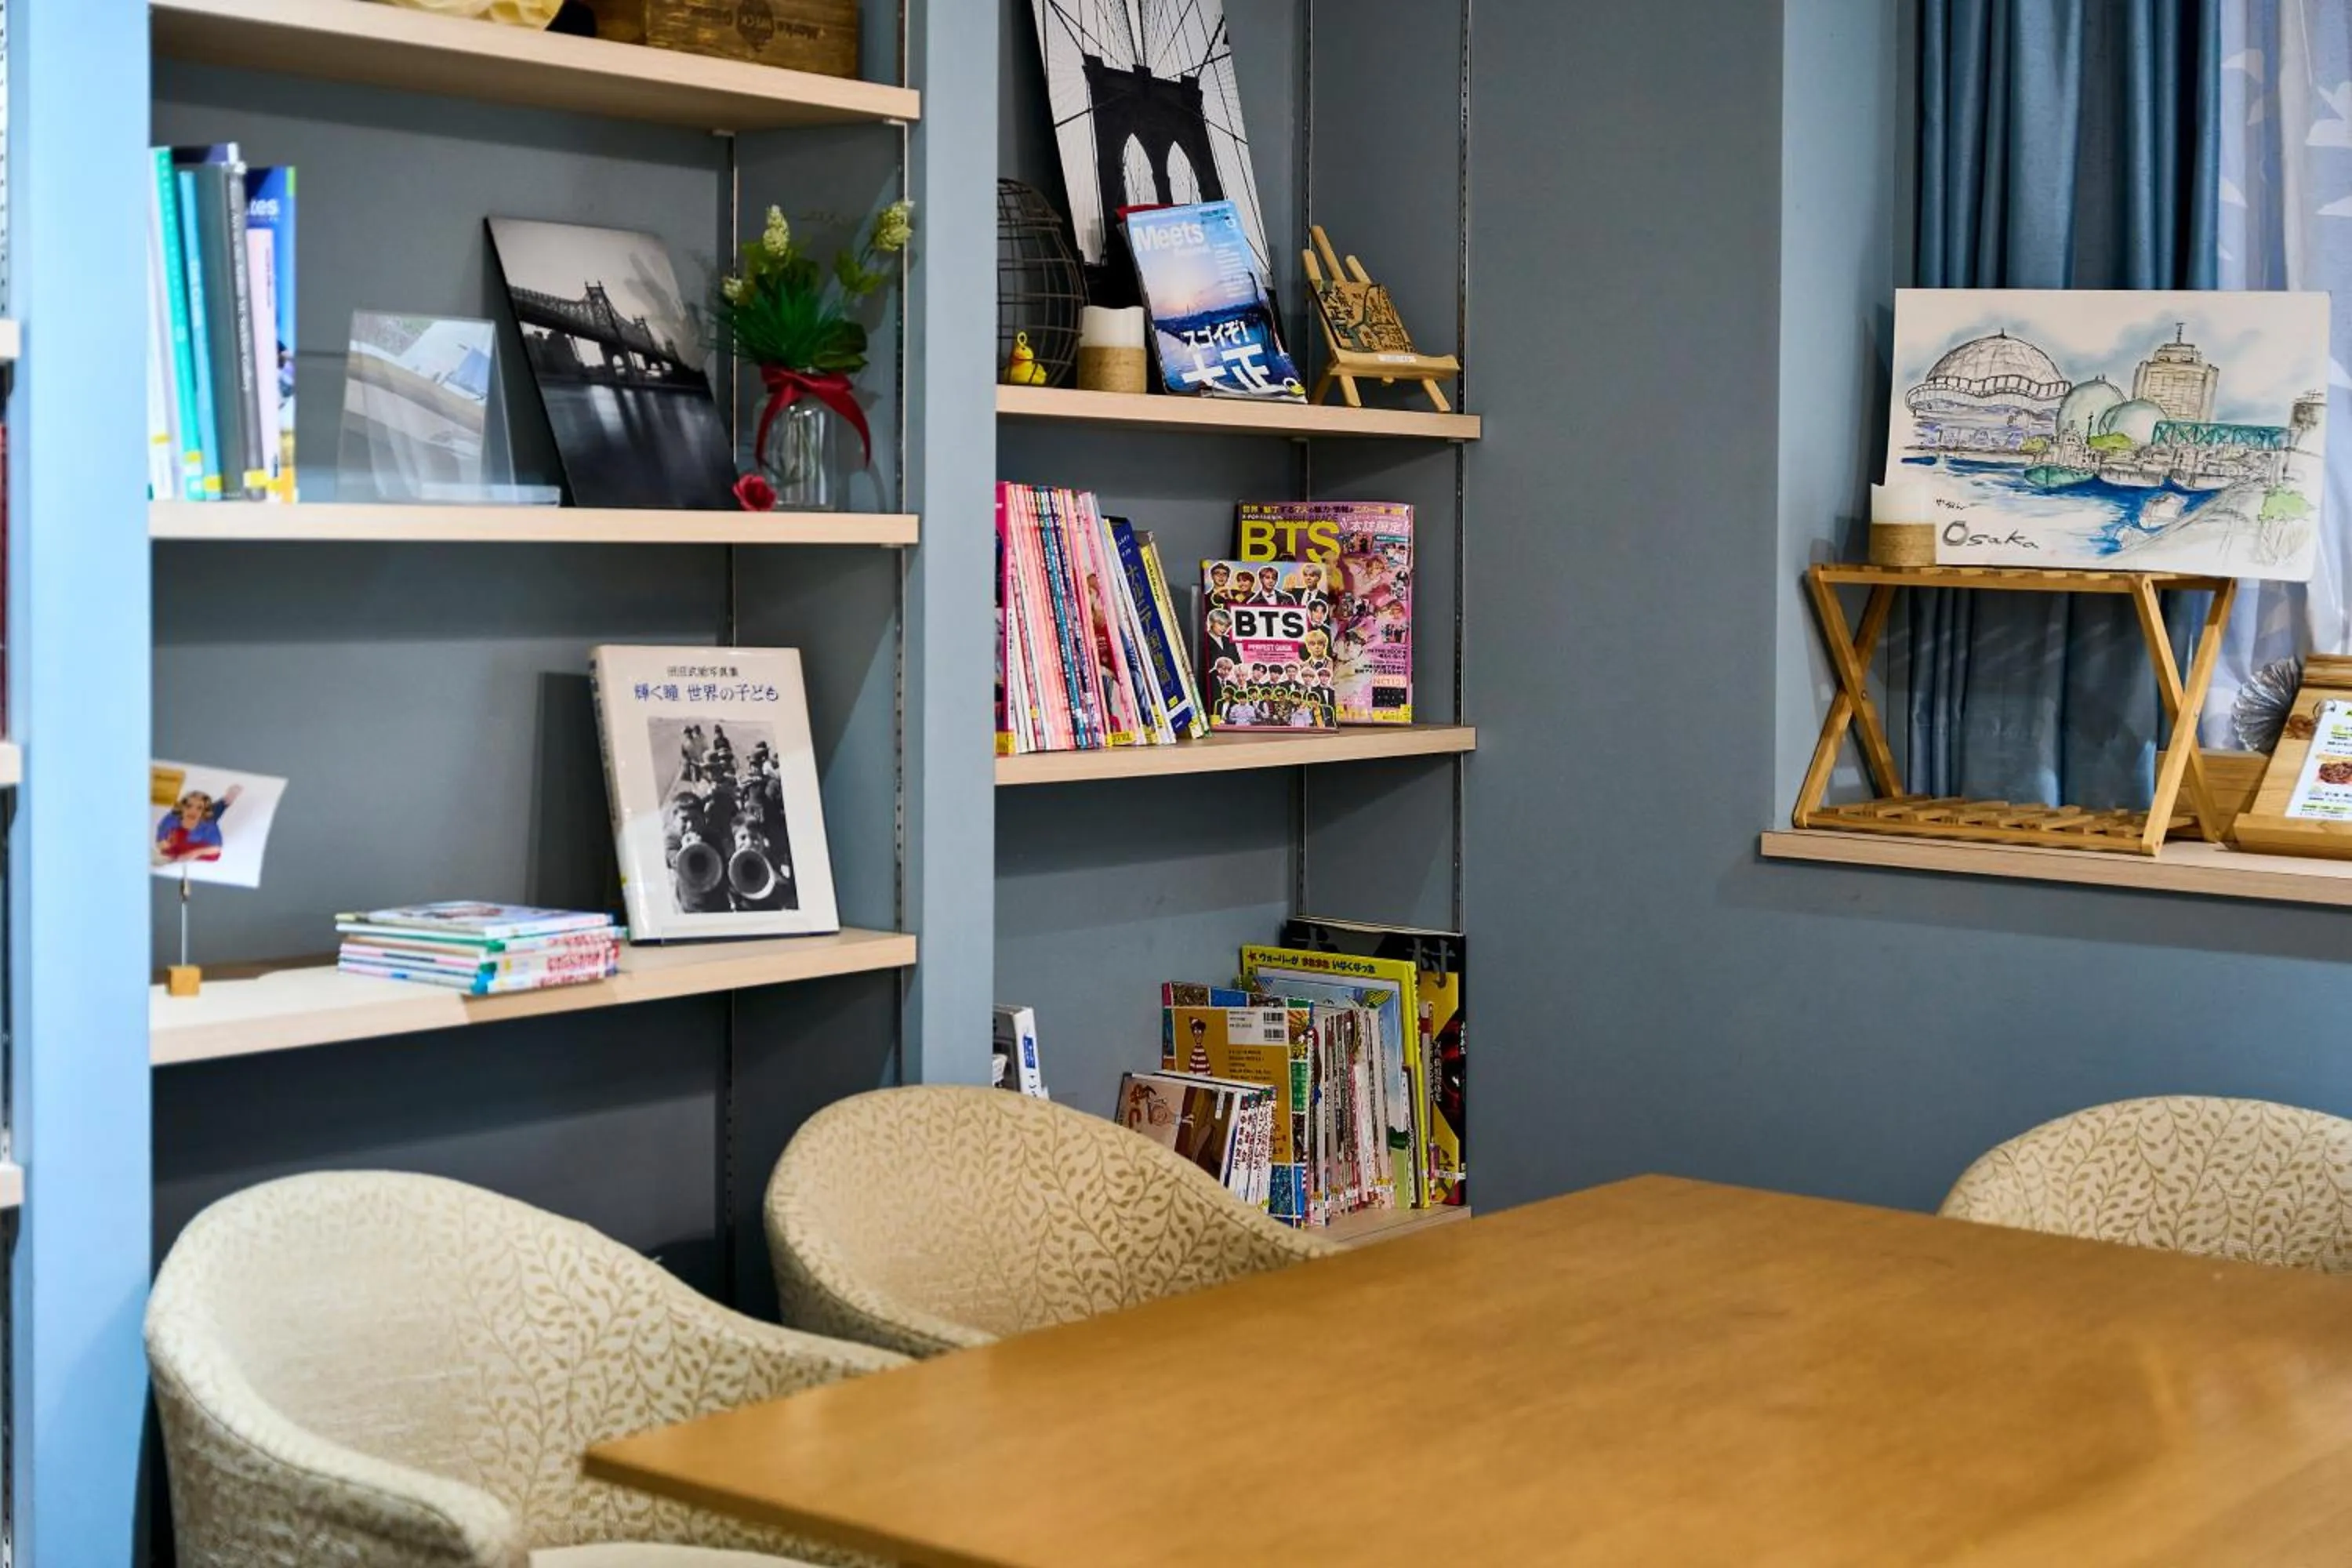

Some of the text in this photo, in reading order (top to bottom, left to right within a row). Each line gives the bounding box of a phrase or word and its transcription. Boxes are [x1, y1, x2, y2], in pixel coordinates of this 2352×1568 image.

[1133, 222, 1204, 252] Meets
[1241, 520, 1340, 562] BTS
[1943, 521, 2039, 549] Osaka
[1235, 610, 1304, 638] BTS
[634, 684, 779, 702] 輝く瞳 世界の子ども
